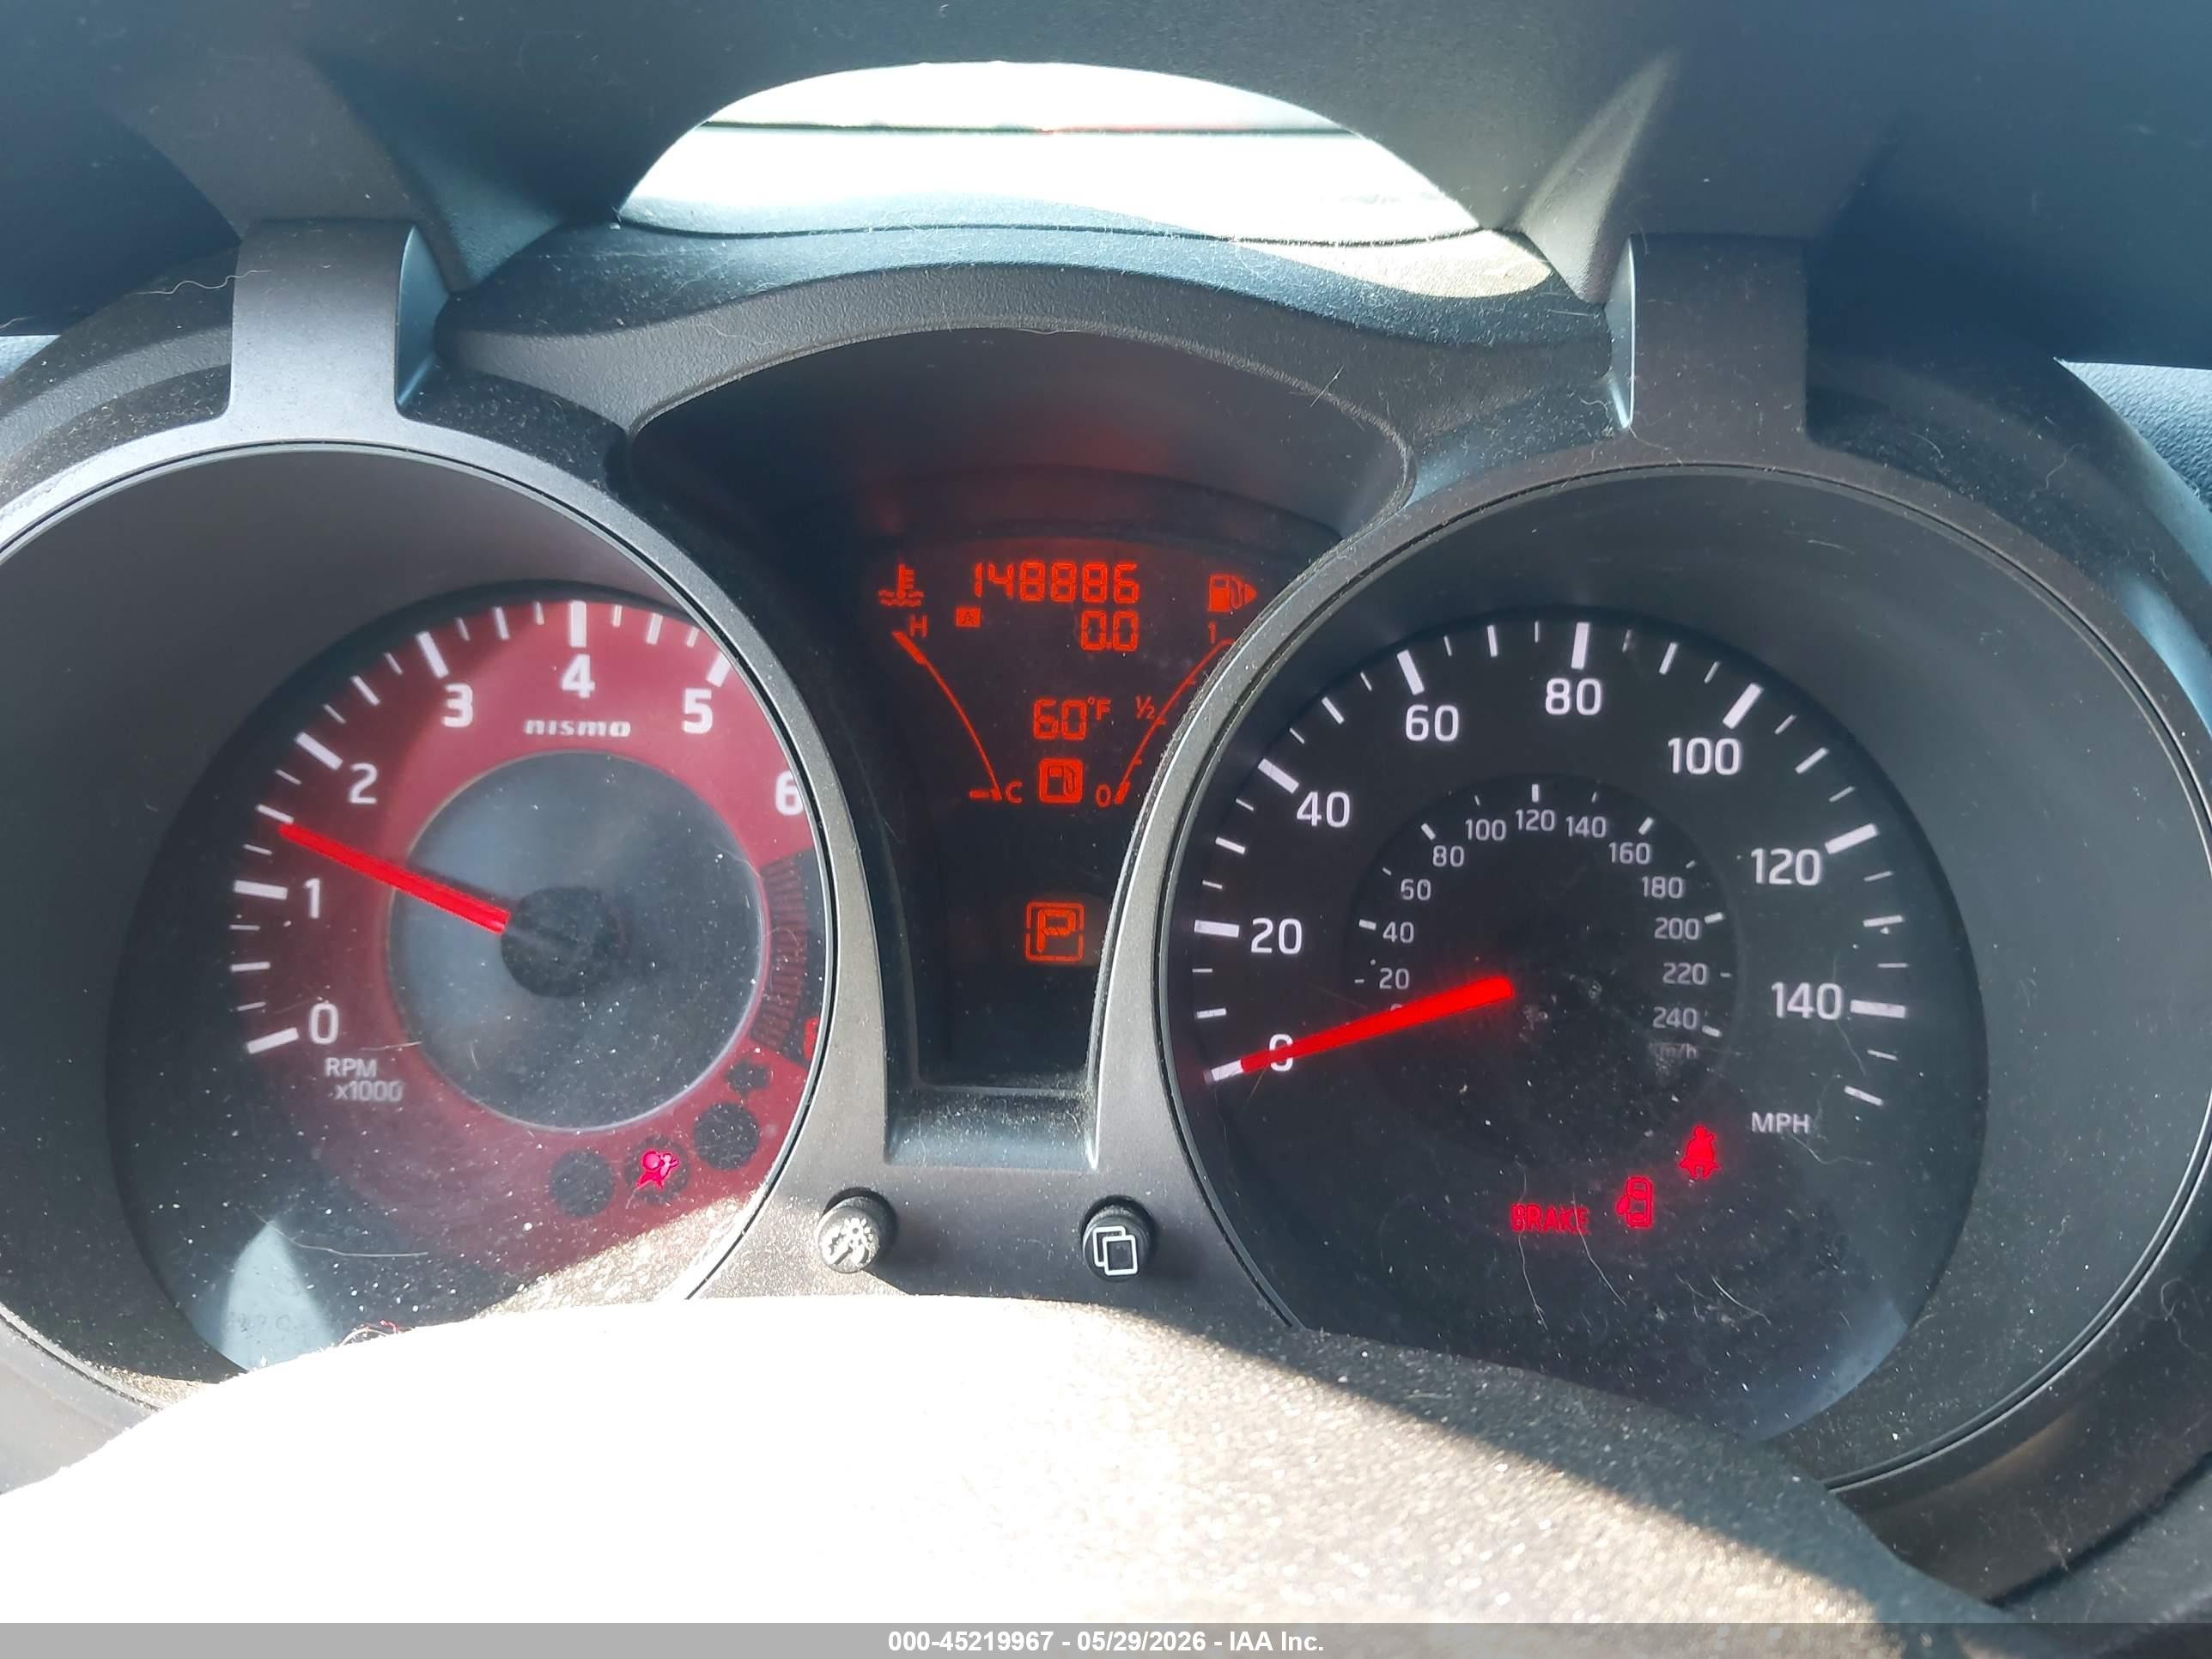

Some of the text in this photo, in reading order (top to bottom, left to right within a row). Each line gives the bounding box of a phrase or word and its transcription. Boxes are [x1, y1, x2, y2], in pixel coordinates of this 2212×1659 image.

[974, 560, 1140, 604] 148886
[908, 615, 928, 638] H
[1080, 610, 1139, 652] 0.0
[1207, 622, 1218, 645] 1
[561, 653, 596, 699] 4
[442, 684, 474, 728] 3
[1546, 678, 1602, 716] 80
[682, 688, 714, 734] 5
[1405, 704, 1460, 743] 60
[525, 720, 632, 739] nismo
[1668, 736, 1742, 776] 100
[349, 763, 379, 805] 2
[775, 770, 804, 816] 6
[1005, 781, 1024, 804] C
[1296, 791, 1351, 829] 40
[1516, 809, 1556, 832] 120
[1464, 818, 1507, 842] 100
[1565, 816, 1607, 839] 140
[1431, 845, 1465, 868] 80
[1608, 842, 1652, 866] 160
[1750, 848, 1822, 887] 120
[305, 878, 320, 920] 1
[1400, 878, 1432, 901] 60
[1641, 876, 1685, 899] 180
[1037, 909, 1076, 952] P
[1250, 917, 1304, 956] 20
[1382, 921, 1415, 945] 40
[1653, 917, 1701, 941] 200
[1378, 967, 1411, 991] 20
[1662, 962, 1709, 987] 220
[1771, 981, 1844, 1021] 140
[309, 1000, 339, 1045] 0
[1652, 1006, 1698, 1030] 240
[1268, 1033, 1294, 1073] 0
[1650, 1042, 1698, 1059] m/h
[325, 1057, 378, 1079] RPM
[335, 1080, 404, 1103] x1000
[1751, 1111, 1811, 1134] MPH
[1510, 1203, 1589, 1234] BRAKE
